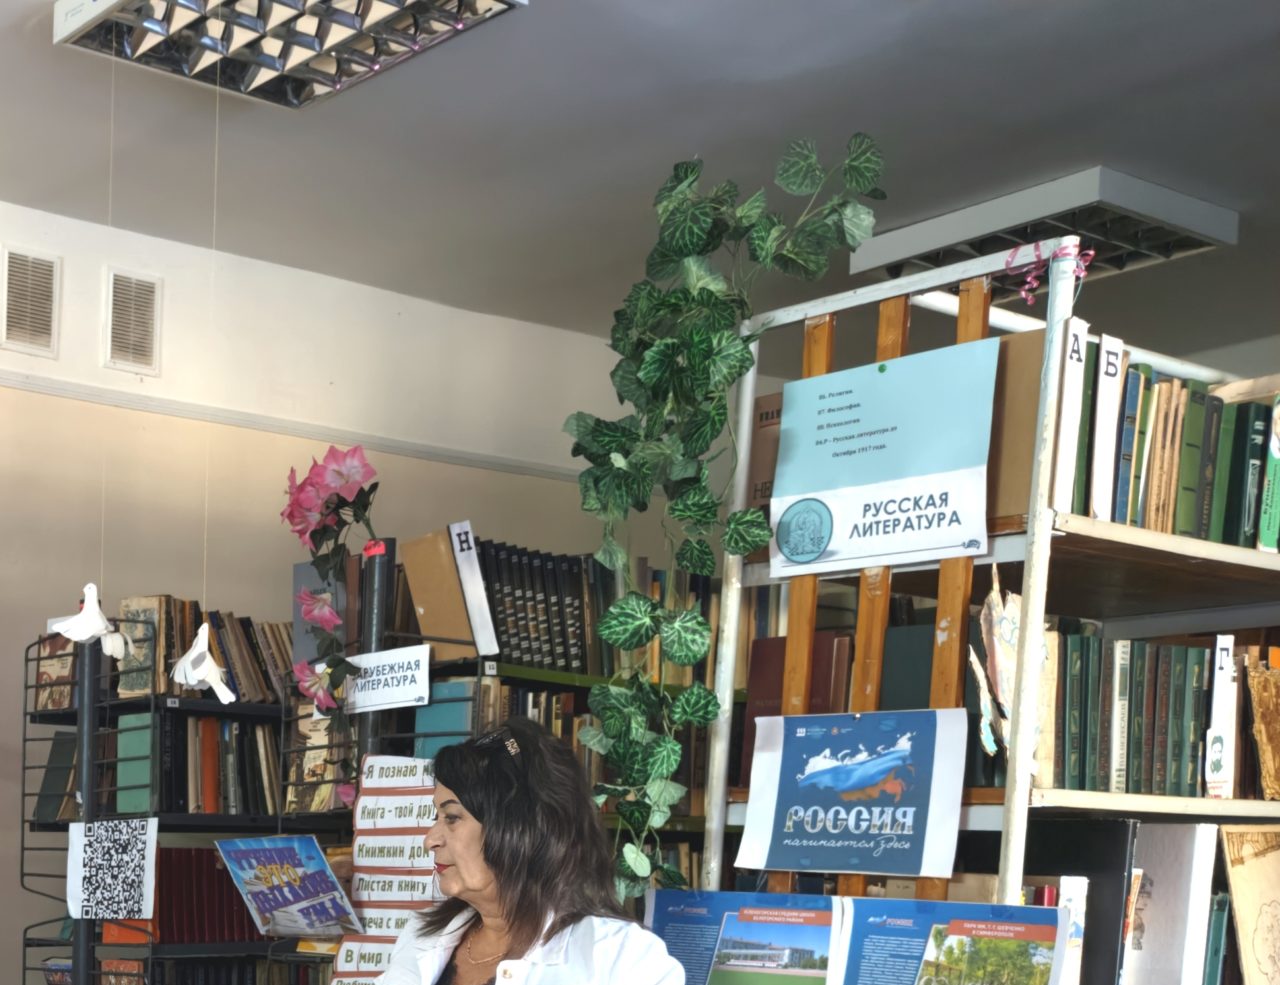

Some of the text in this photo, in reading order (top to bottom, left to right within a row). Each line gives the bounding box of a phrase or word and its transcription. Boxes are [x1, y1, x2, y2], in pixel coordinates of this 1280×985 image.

[1069, 333, 1083, 363] А
[1104, 350, 1119, 378] Б
[863, 492, 949, 519] РУССКАЯ
[849, 510, 962, 540] ЛИТЕРАТУРА
[456, 530, 473, 552] Н
[1219, 647, 1230, 671] Г
[354, 673, 418, 693] ЛИТЕРАТУРА
[366, 765, 374, 780] Я
[378, 764, 418, 779] познаю
[361, 805, 385, 821] Книга
[394, 803, 414, 819] твой
[783, 804, 917, 835] РОССИЯ
[357, 843, 404, 859] Книжкин
[255, 863, 301, 888] ЭТО
[356, 878, 427, 895] Листая книгу
[386, 917, 391, 929] с
[345, 949, 382, 967] В мир
